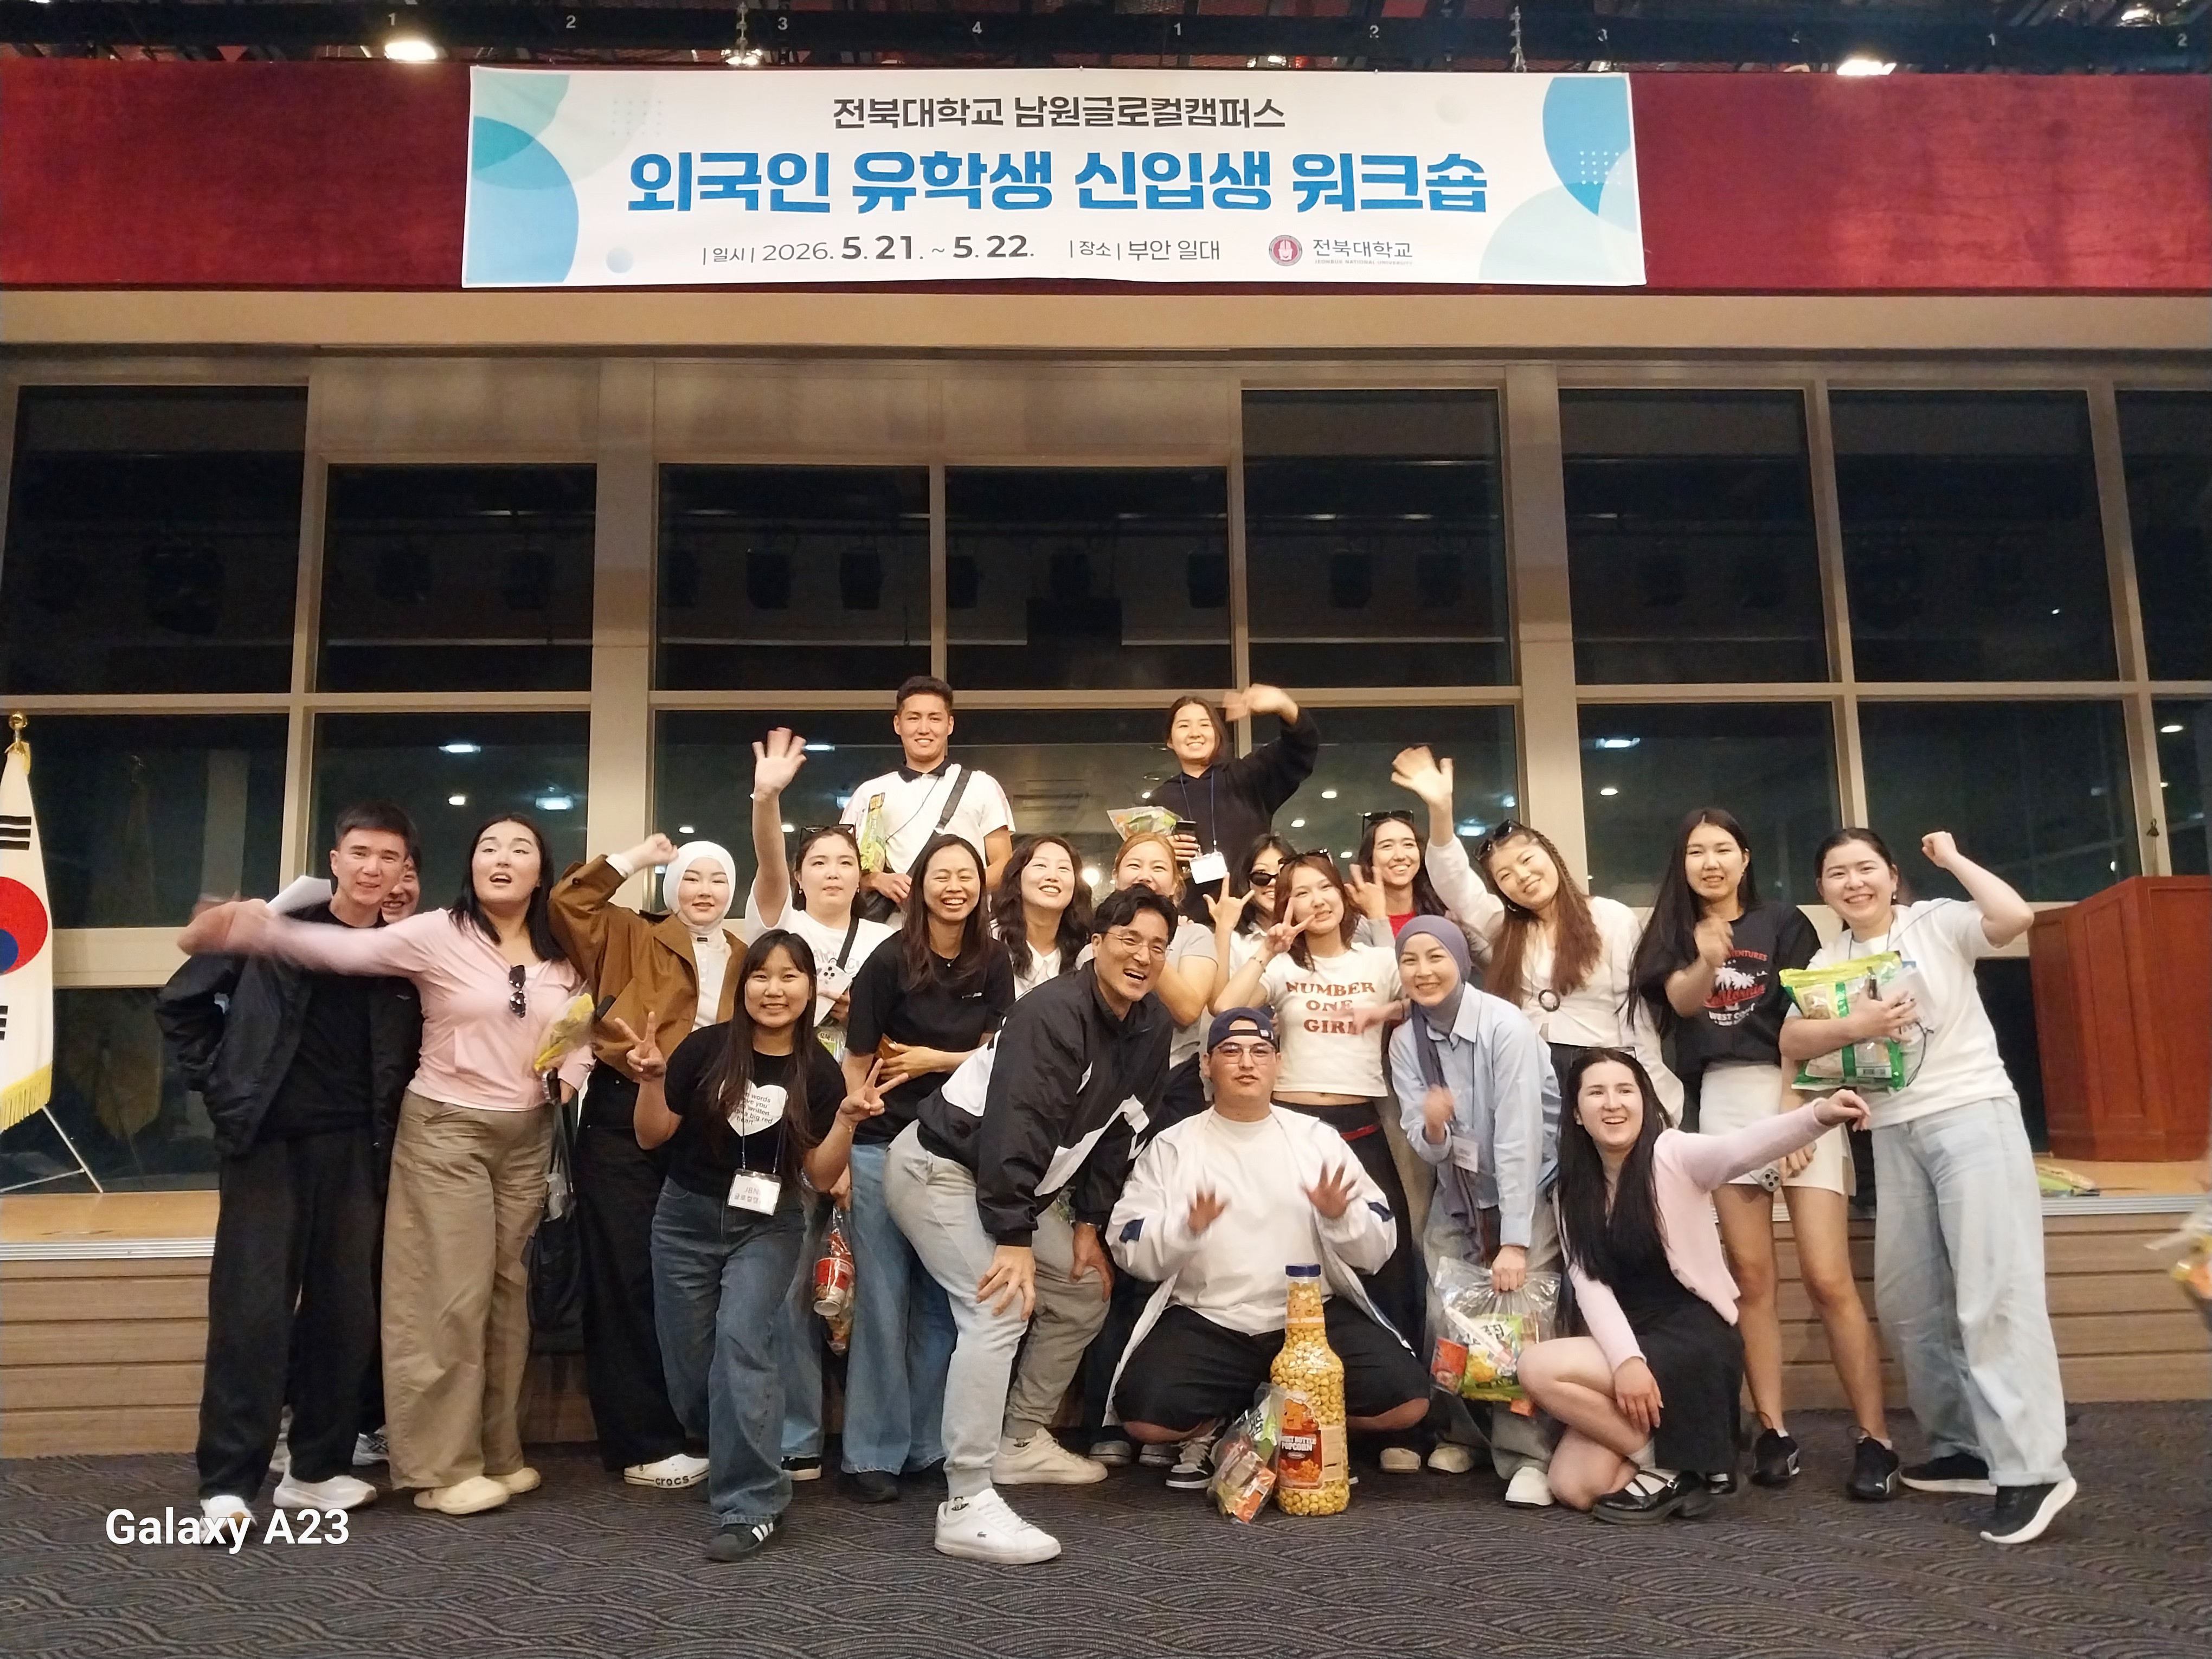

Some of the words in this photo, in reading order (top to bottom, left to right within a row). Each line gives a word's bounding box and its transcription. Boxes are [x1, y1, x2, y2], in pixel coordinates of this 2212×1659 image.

[388, 12, 396, 26] 1
[566, 15, 576, 29] 2
[777, 17, 788, 30] 3
[972, 21, 982, 34] 4
[1173, 22, 1181, 36] 1
[1369, 25, 1379, 38] 2
[2178, 33, 2188, 47] 2
[834, 98, 1004, 128] 전북대학교
[1015, 96, 1285, 128] 남원글로컬캠퍼스
[628, 152, 830, 213] 외국인
[852, 151, 1052, 214] 유학생
[1075, 151, 1271, 210] 신입생
[1293, 153, 1487, 213] 워크숍
[763, 242, 833, 261] 2026.
[1128, 240, 1171, 261] 부안
[1178, 241, 1219, 260] 일대
[1313, 239, 1413, 258] 전북대학교
[1285, 981, 1375, 996] NUMBER
[1306, 1000, 1354, 1012] ONE
[751, 1094, 771, 1103] words
[748, 1107, 770, 1116] written
[736, 1116, 754, 1126] heart
[750, 1113, 760, 1121] big
[761, 1116, 773, 1124] red
[1281, 1442, 1313, 1451] POPCORN
[655, 1475, 690, 1486] crocs
